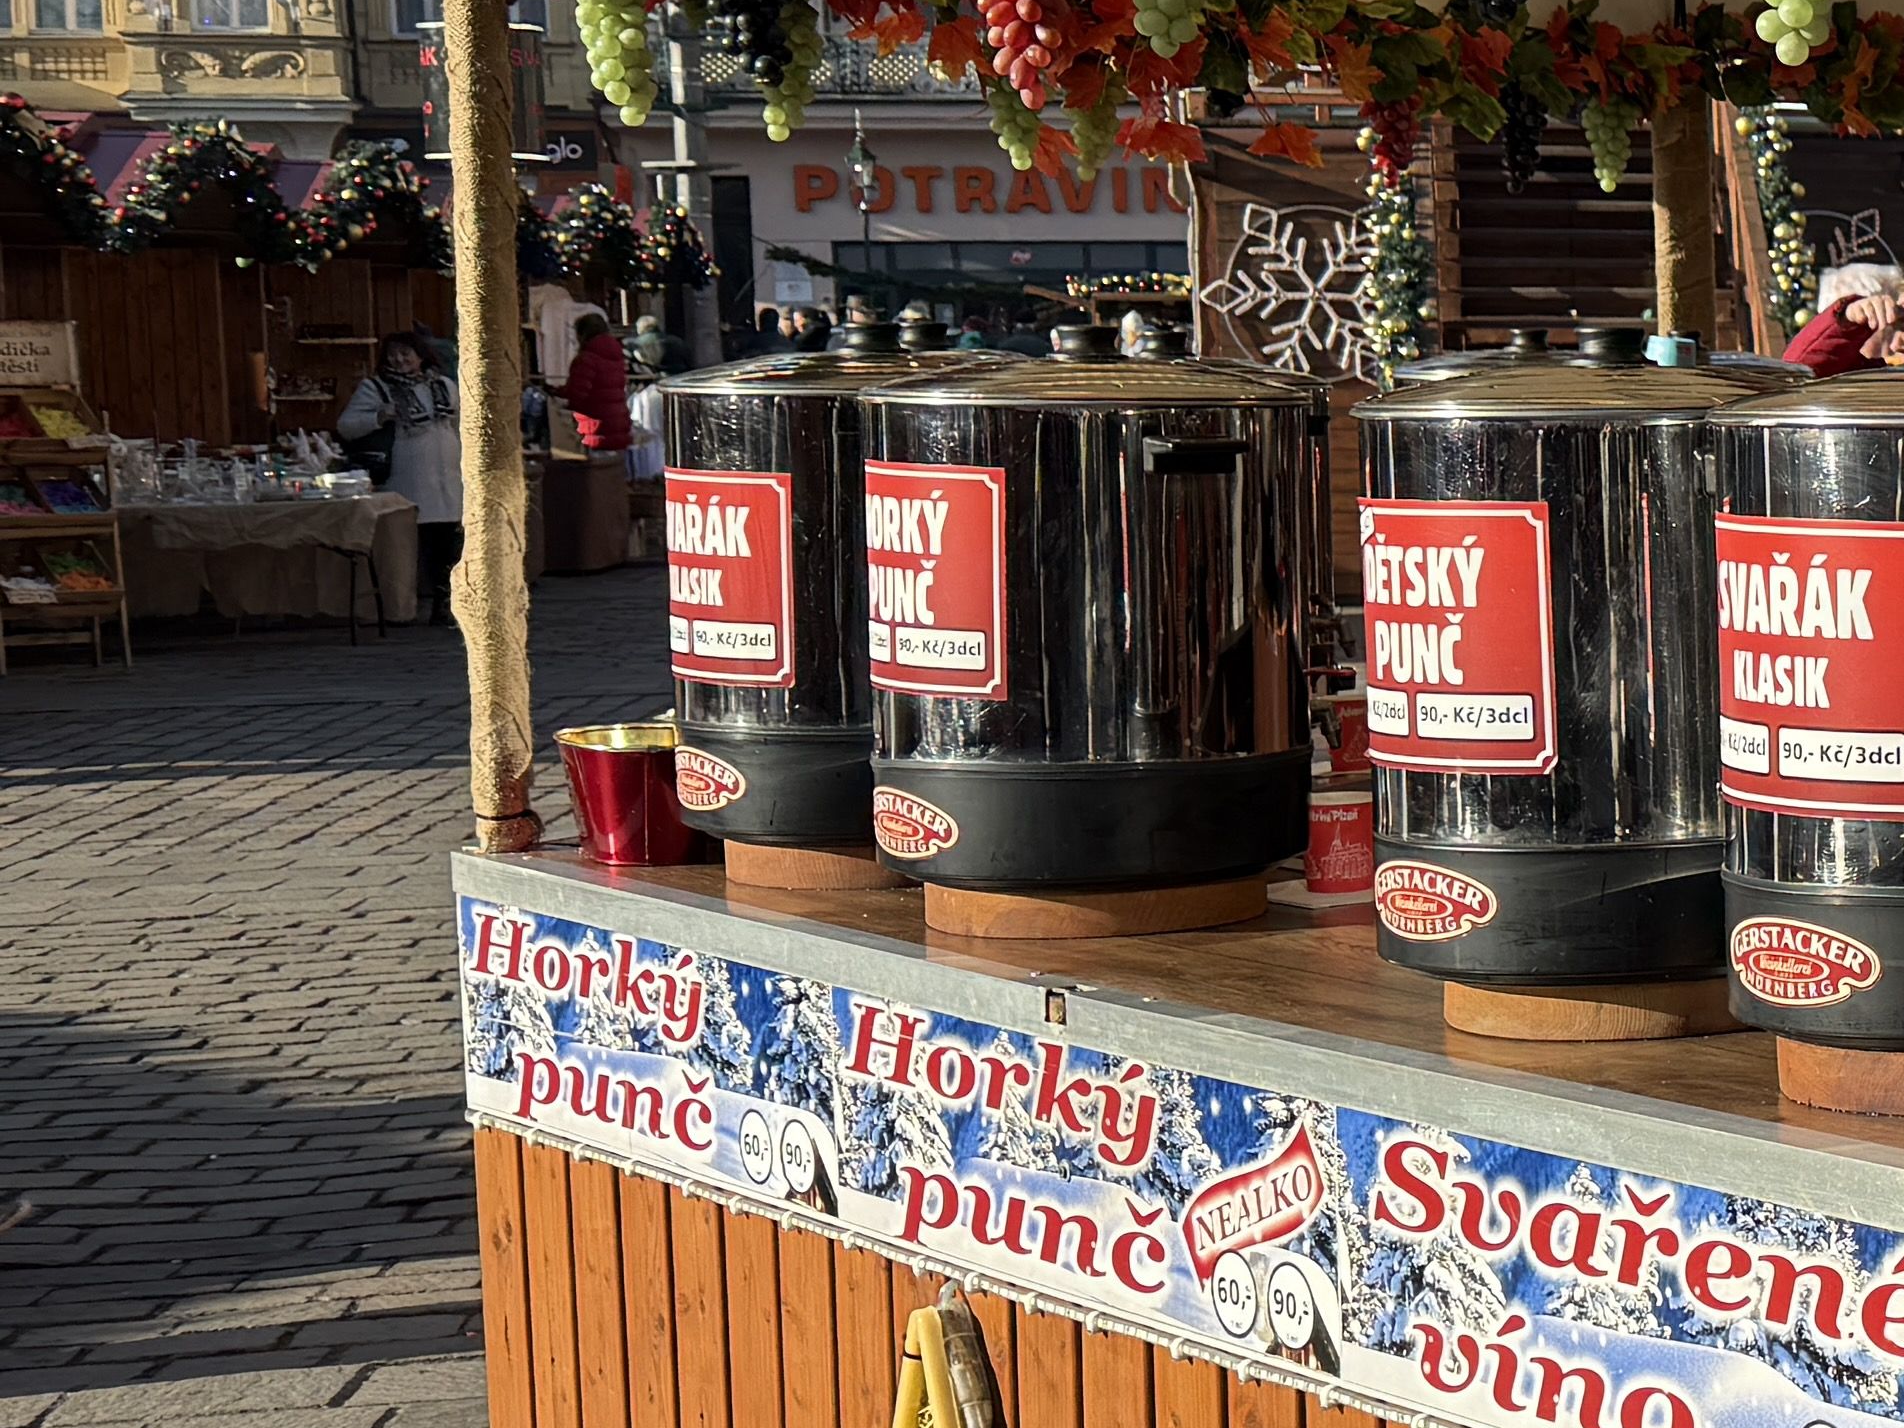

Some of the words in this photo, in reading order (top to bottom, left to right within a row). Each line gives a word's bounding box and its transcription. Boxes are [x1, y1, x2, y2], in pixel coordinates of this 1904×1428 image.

[794, 164, 1188, 214] POTRAVIN
[1363, 533, 1485, 608] DĚTSKÝ
[1718, 551, 1874, 640] SVAŘÁK
[1374, 612, 1464, 685] PUNČ
[1733, 649, 1830, 708] KLASIK
[1419, 705, 1448, 724] 90,-
[1453, 705, 1528, 728] Kč/3dcl
[1783, 742, 1814, 763] 90,-
[1820, 744, 1901, 768] Kč/3dcl
[470, 912, 703, 1043] Horký
[1735, 926, 1866, 974] GERSTACKER
[514, 1050, 714, 1151] punč
[846, 1002, 1157, 1166] Horký
[900, 1165, 1166, 1294] punč
[1196, 1164, 1312, 1251] NEALKO
